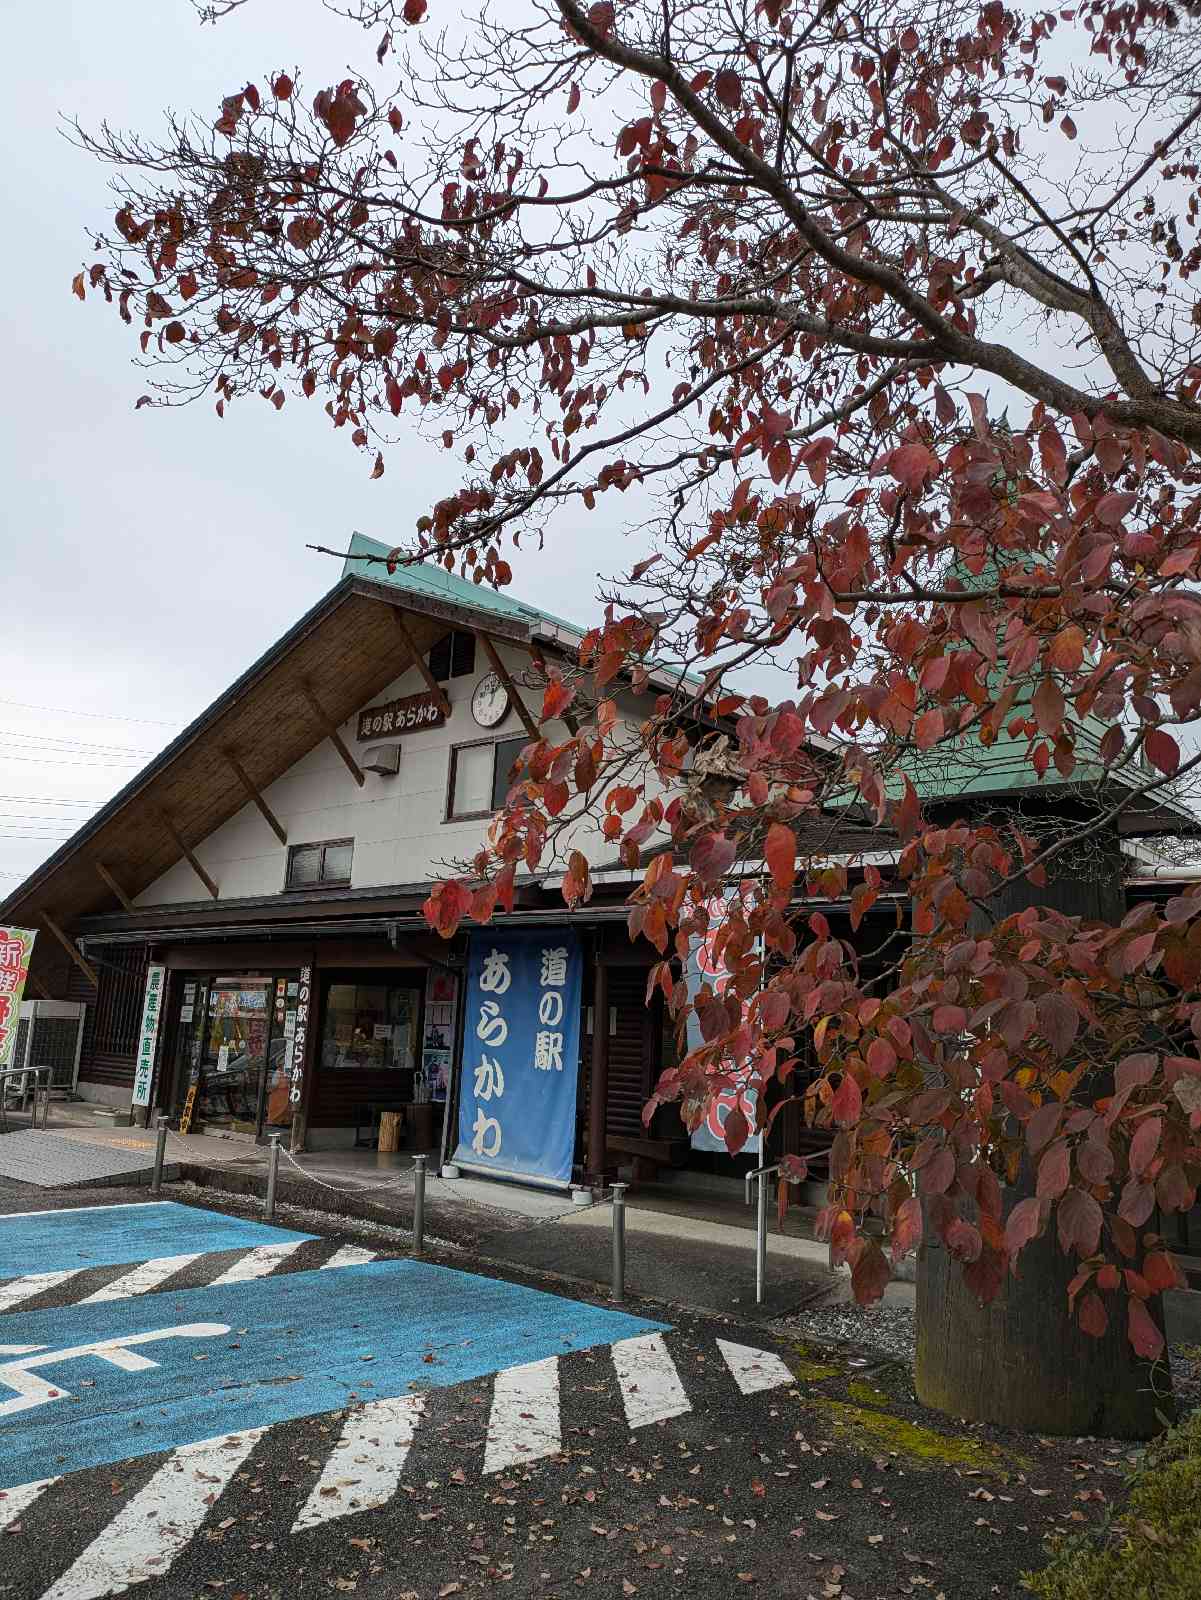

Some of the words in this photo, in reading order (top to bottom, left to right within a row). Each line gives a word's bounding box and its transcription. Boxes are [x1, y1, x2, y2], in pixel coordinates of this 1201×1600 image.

[136, 971, 161, 1100] 農産物直売所
[289, 966, 311, 1102] 道の駅あらかわ
[471, 948, 511, 1157] あらかわ
[534, 947, 568, 1071] 道の駅
